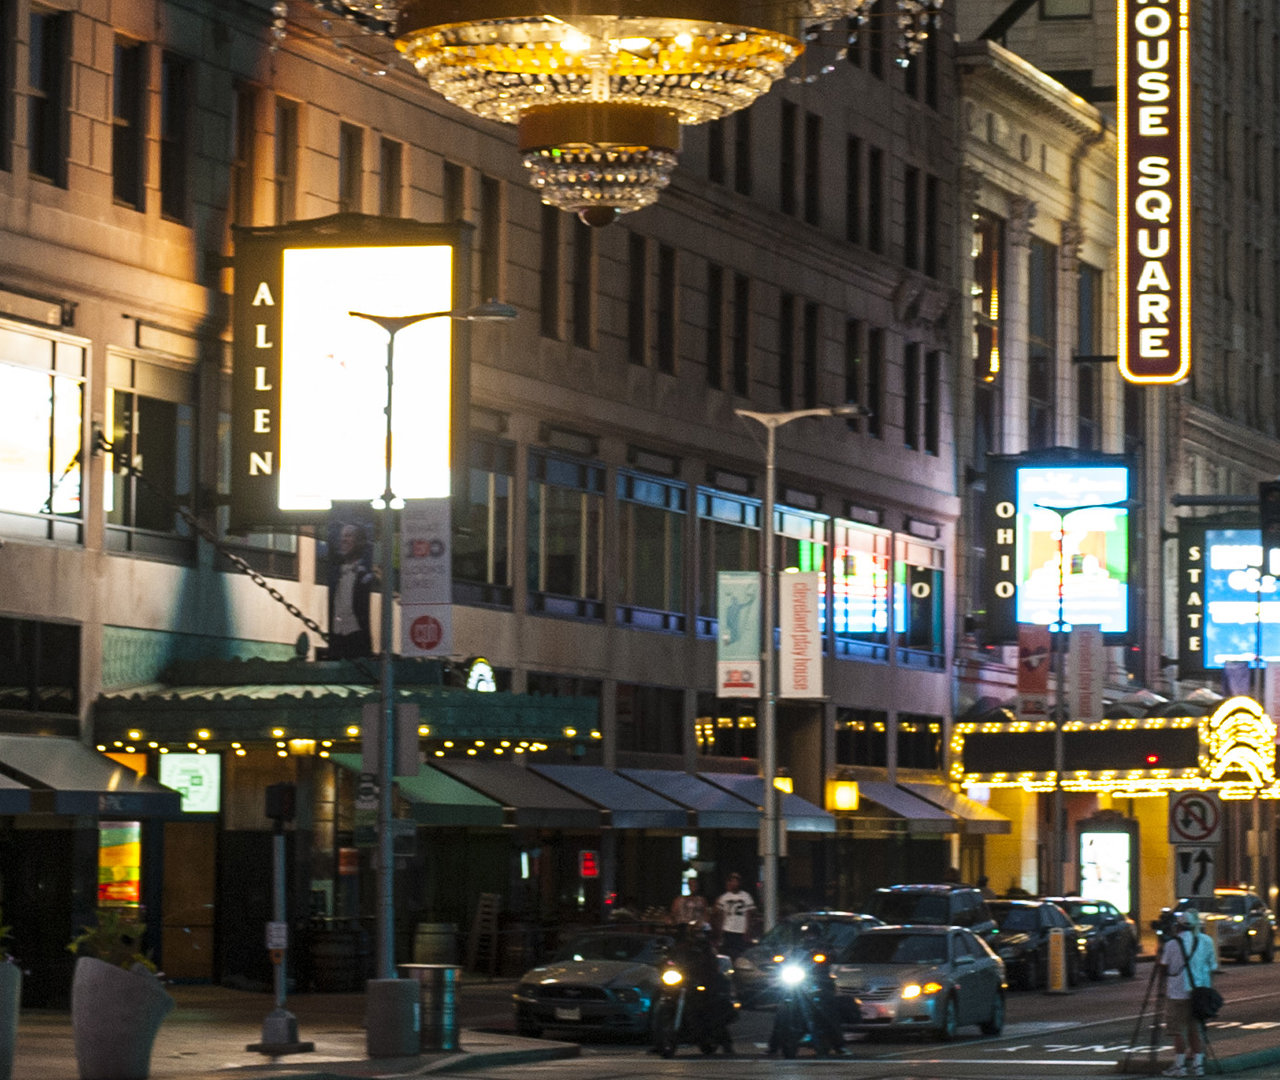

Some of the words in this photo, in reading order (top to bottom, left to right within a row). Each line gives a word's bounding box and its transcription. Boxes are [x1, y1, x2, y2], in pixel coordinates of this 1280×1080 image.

[1135, 156, 1171, 359] SQUARE
[249, 281, 275, 477] ALLEN
[995, 501, 1016, 600] OHIO
[1186, 545, 1203, 653] STATE
[790, 634, 812, 656] play
[792, 582, 812, 633] cleveland
[793, 658, 812, 690] house
